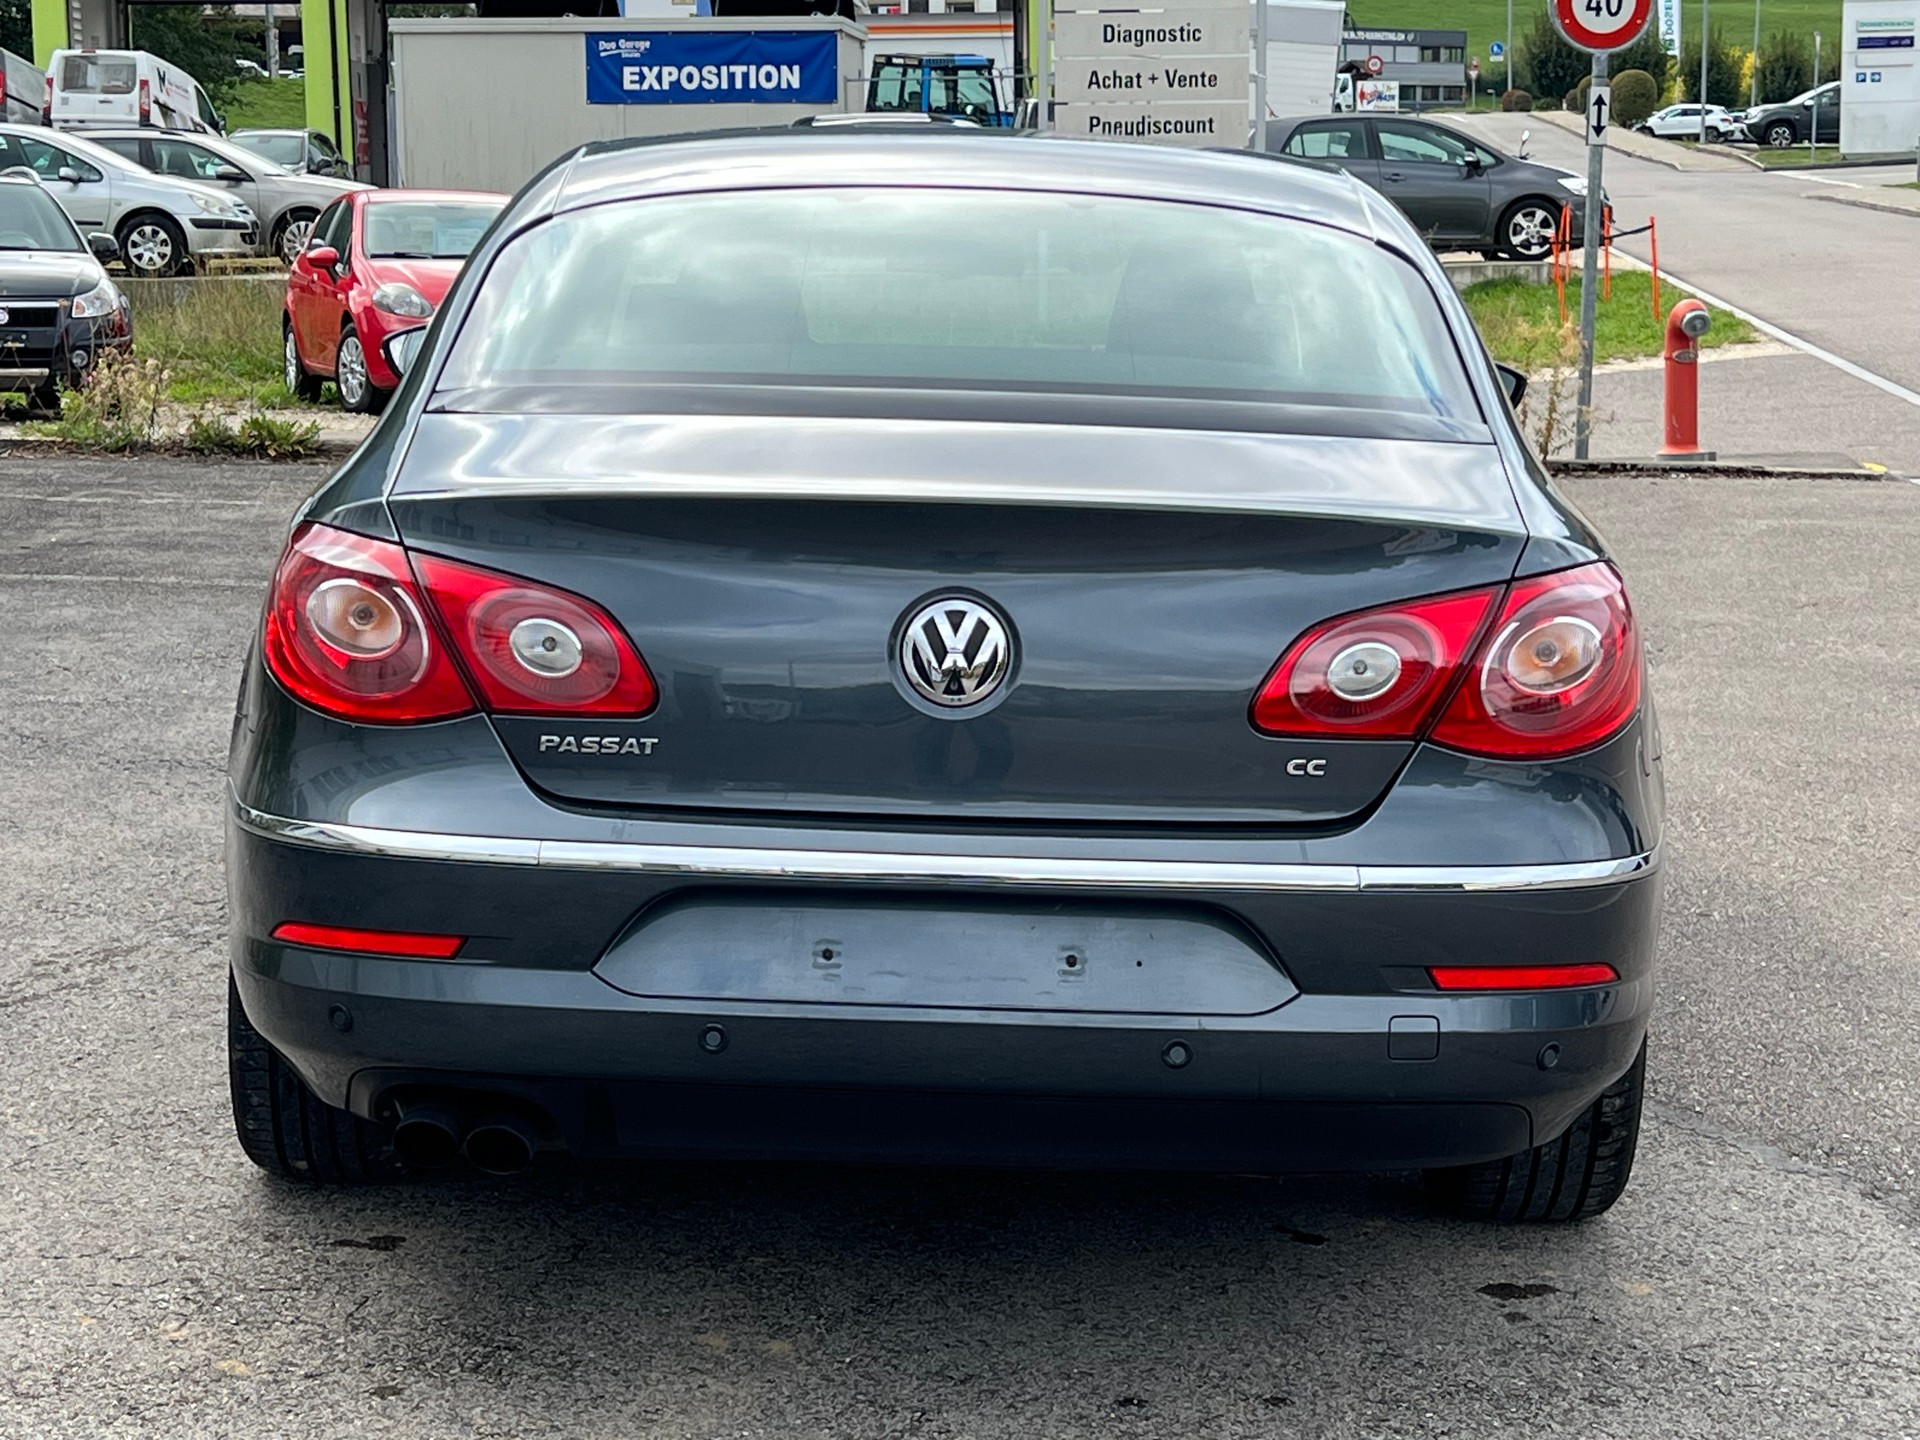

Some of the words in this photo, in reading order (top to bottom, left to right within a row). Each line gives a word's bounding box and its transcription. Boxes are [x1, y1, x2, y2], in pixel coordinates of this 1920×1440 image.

[1585, 0, 1623, 17] 40
[1103, 22, 1202, 47] Diagnostic
[622, 65, 801, 91] EXPOSITION
[1087, 69, 1143, 89] Achat
[1164, 68, 1218, 88] Vente
[1088, 115, 1215, 137] Pneudiscount
[539, 735, 659, 755] PASSAT
[1286, 759, 1327, 776] CC
